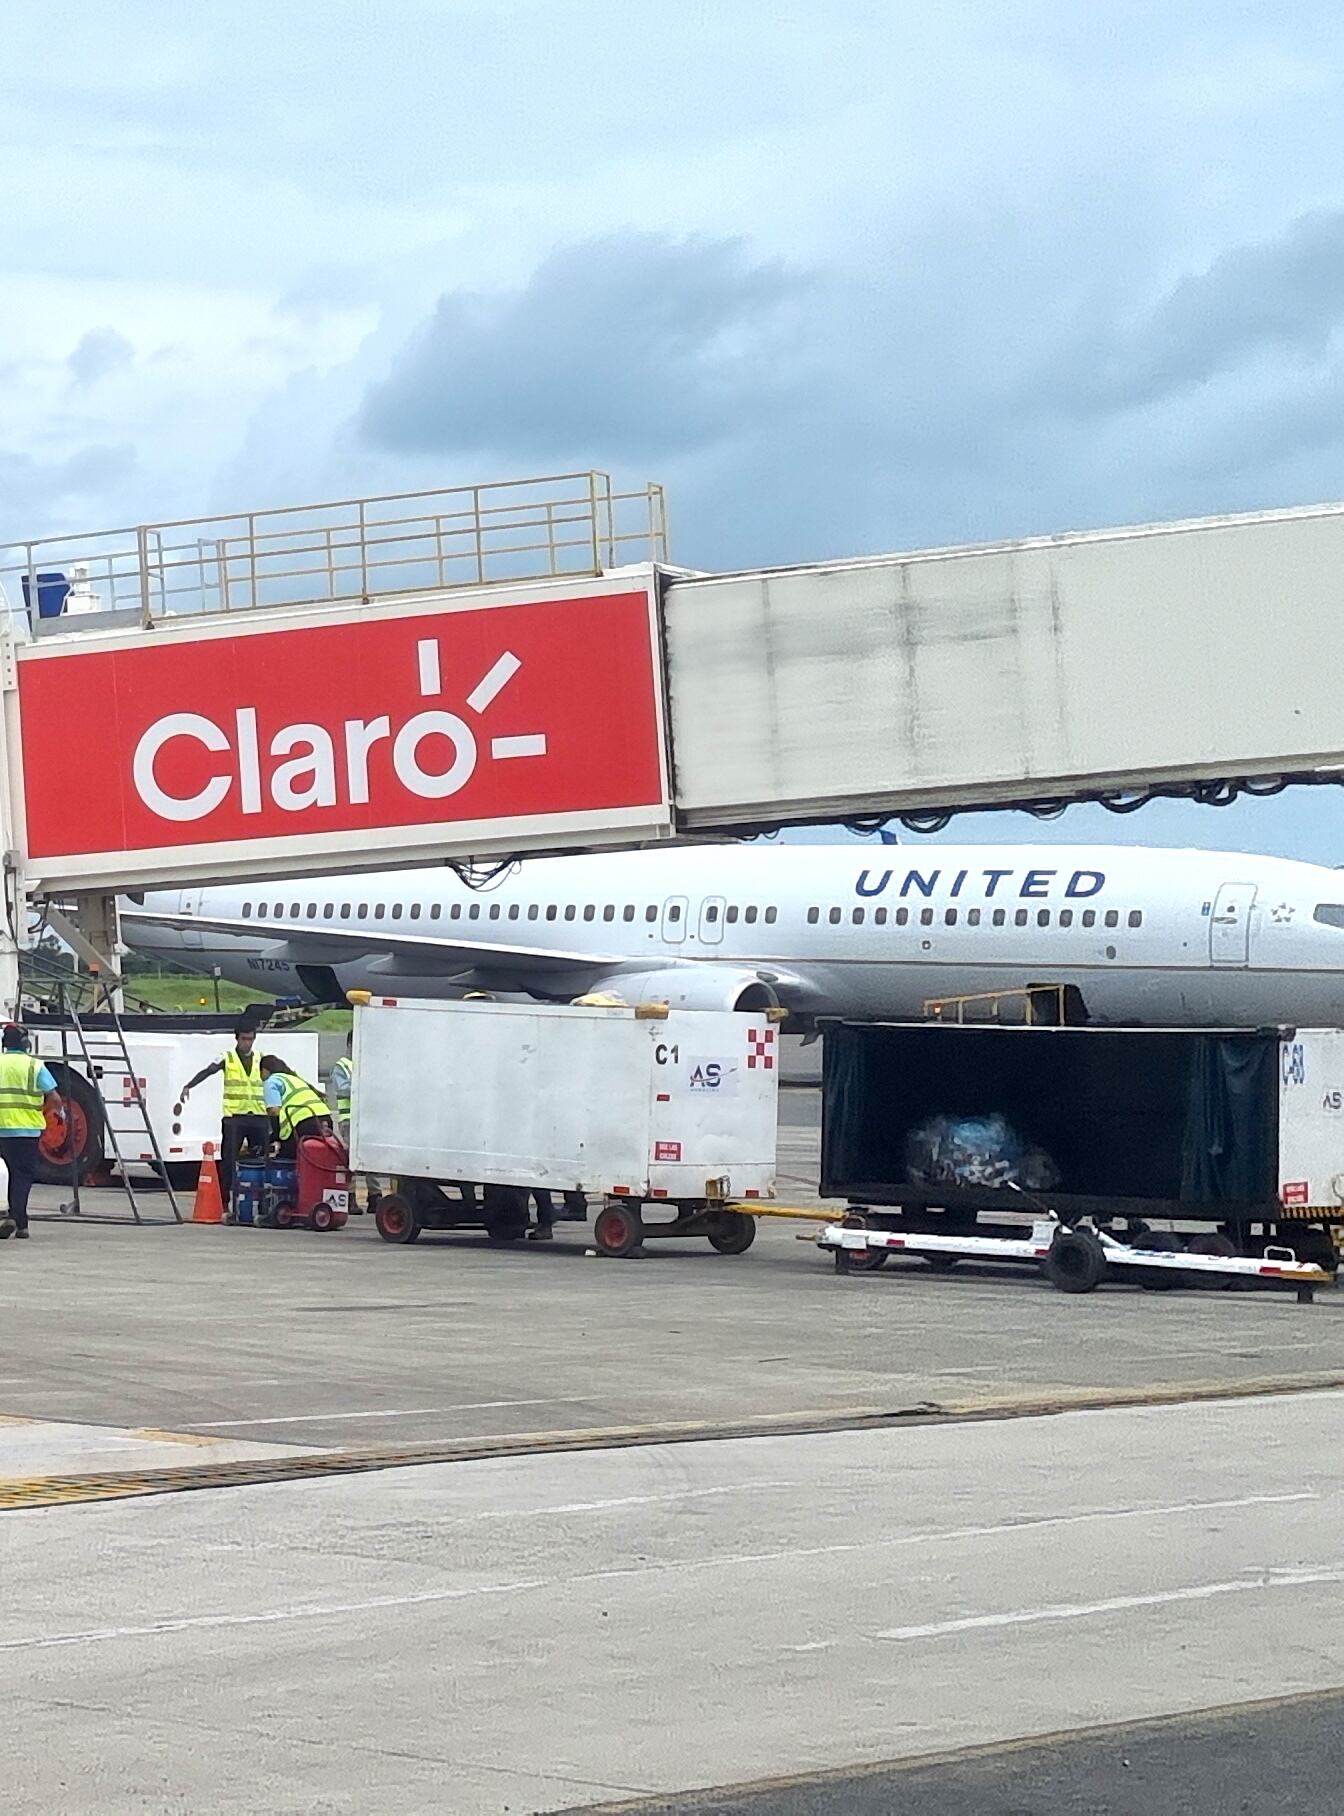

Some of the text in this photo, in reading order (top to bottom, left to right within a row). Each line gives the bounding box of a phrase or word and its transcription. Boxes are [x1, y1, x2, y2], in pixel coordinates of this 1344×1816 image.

[133, 707, 478, 822] Claro
[855, 869, 1106, 898] UNITED
[655, 1044, 679, 1065] C1
[690, 1064, 721, 1088] AS
[326, 1193, 347, 1208] AS
